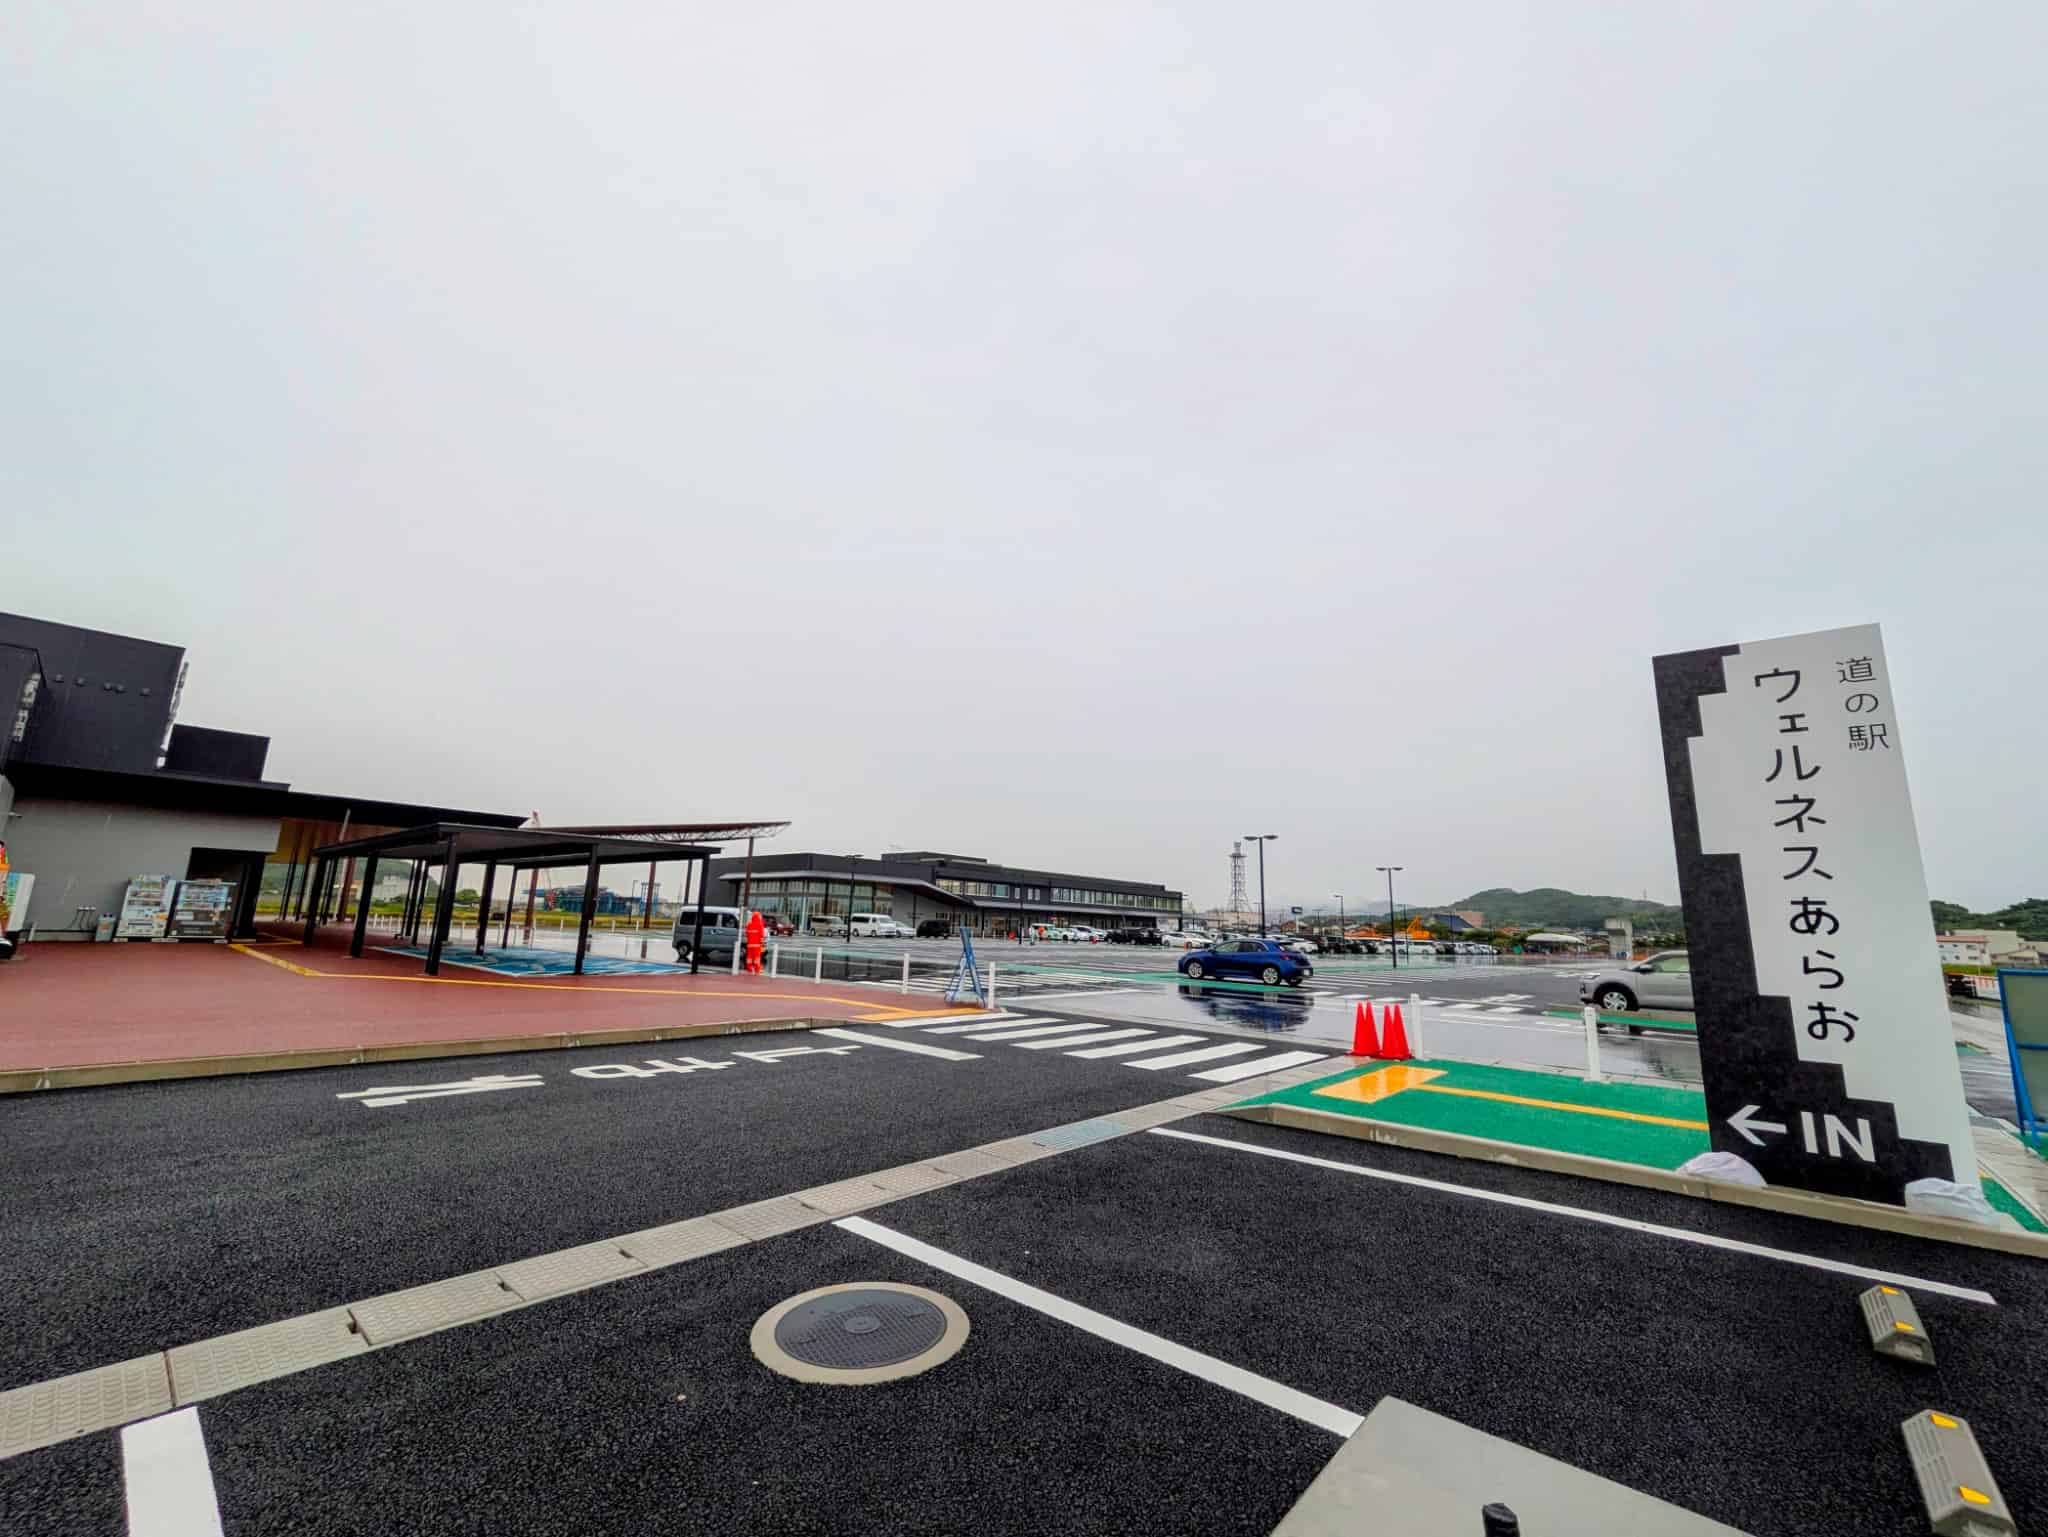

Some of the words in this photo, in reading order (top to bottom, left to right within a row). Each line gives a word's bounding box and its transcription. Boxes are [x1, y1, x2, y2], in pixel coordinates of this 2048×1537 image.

[1834, 655, 1890, 752] 道の駅
[1753, 667, 1860, 1044] ウェルネスあらお
[336, 1044, 863, 1108] 止まれ
[1800, 1111, 1876, 1163] IN
